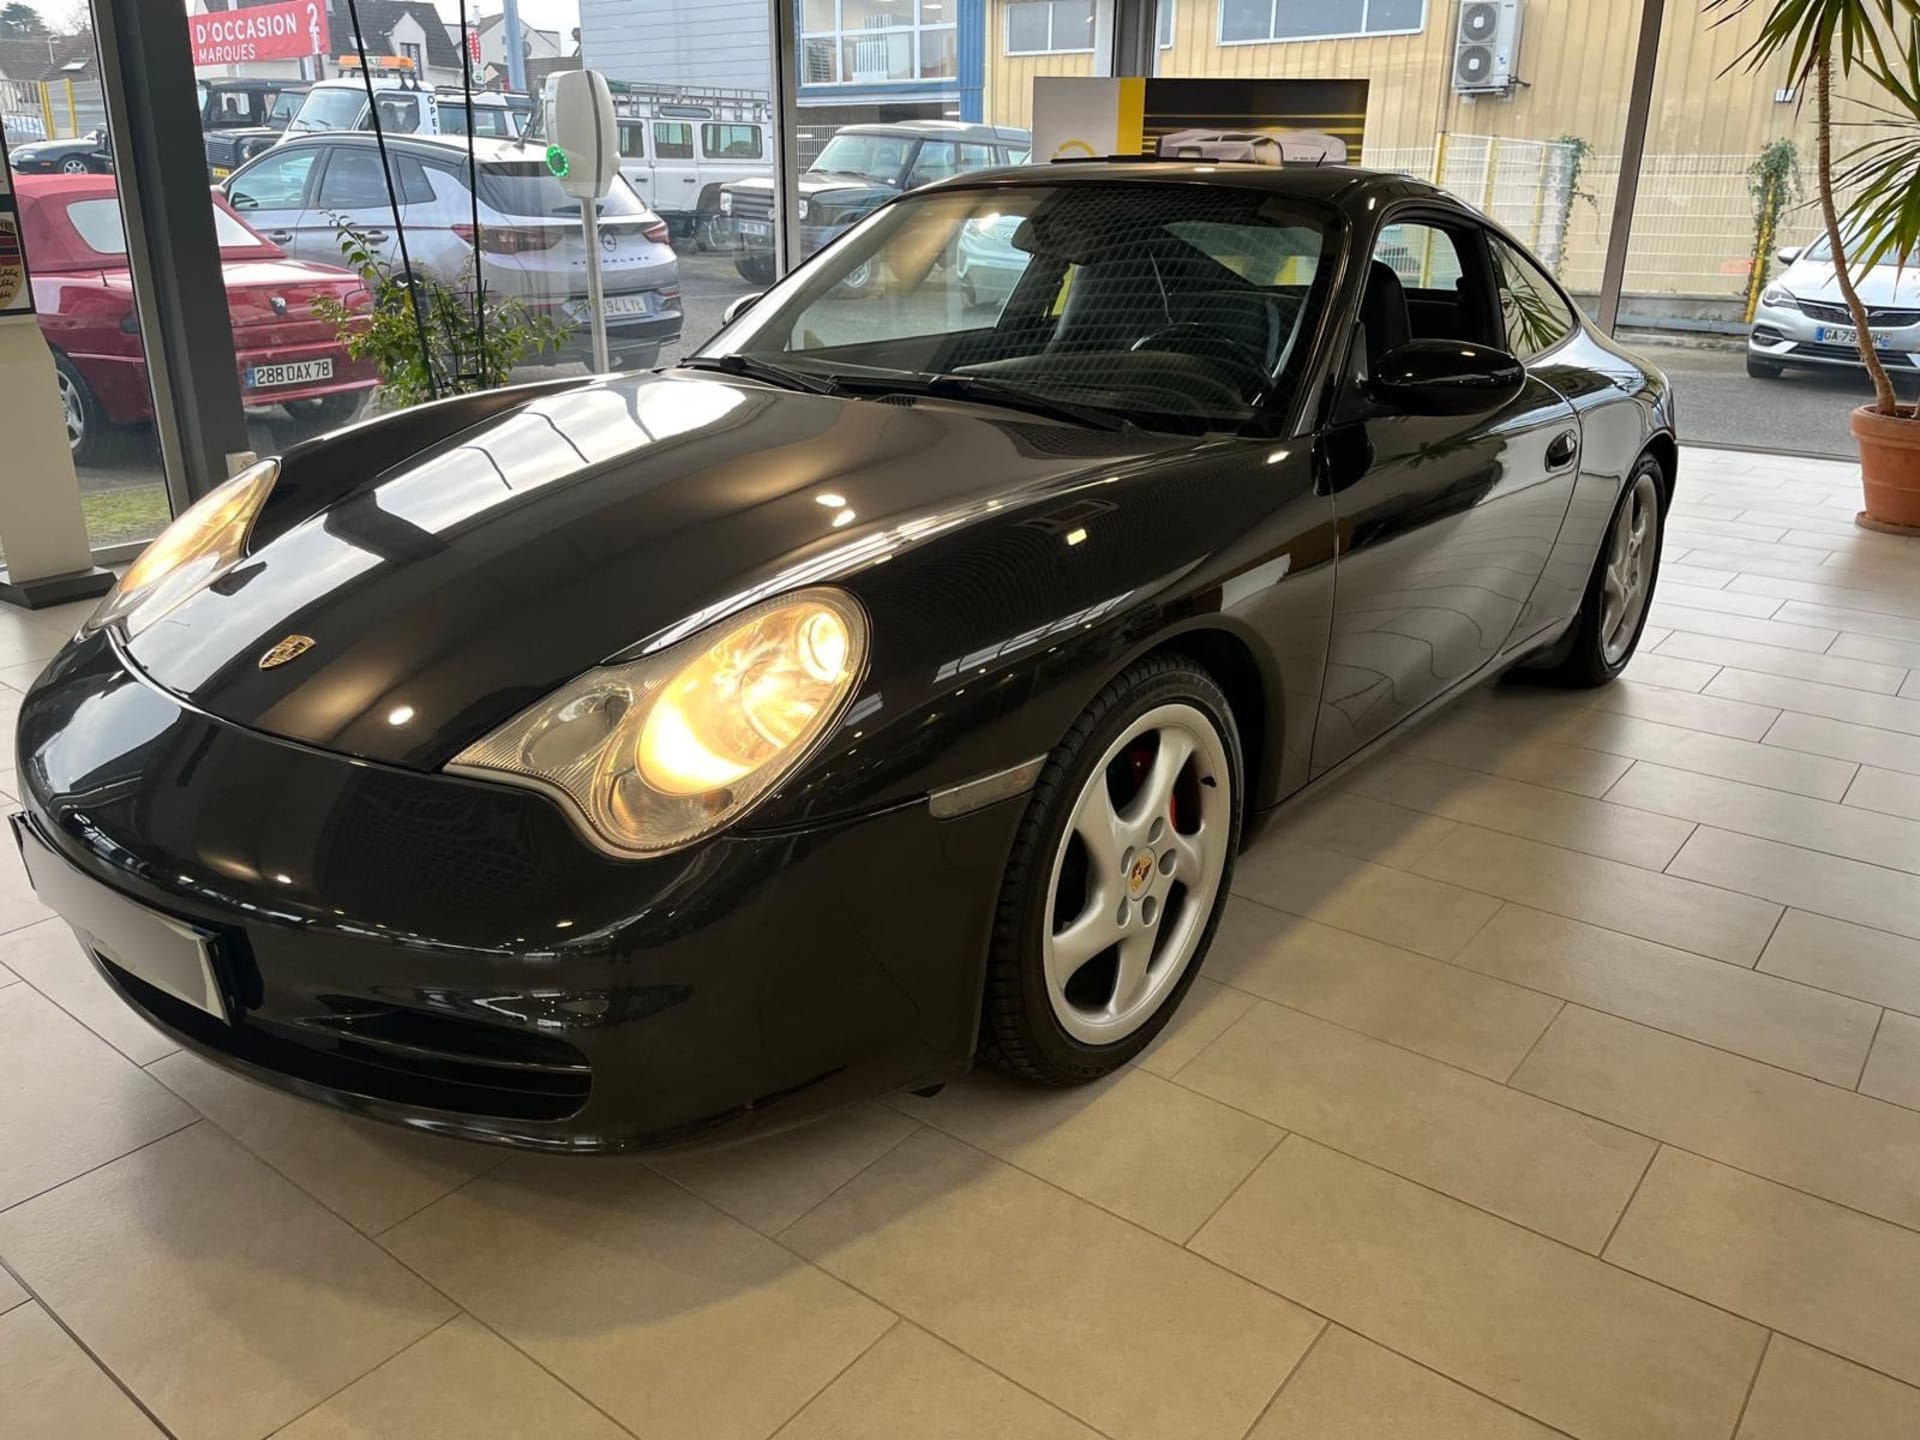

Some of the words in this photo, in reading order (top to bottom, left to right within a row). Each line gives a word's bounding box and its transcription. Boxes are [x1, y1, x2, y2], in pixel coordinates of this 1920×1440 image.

[196, 12, 297, 45] D'OCCASION
[199, 43, 256, 63] MARQUES
[256, 367, 285, 385] 288
[286, 362, 312, 382] DAX
[313, 361, 330, 377] 78
